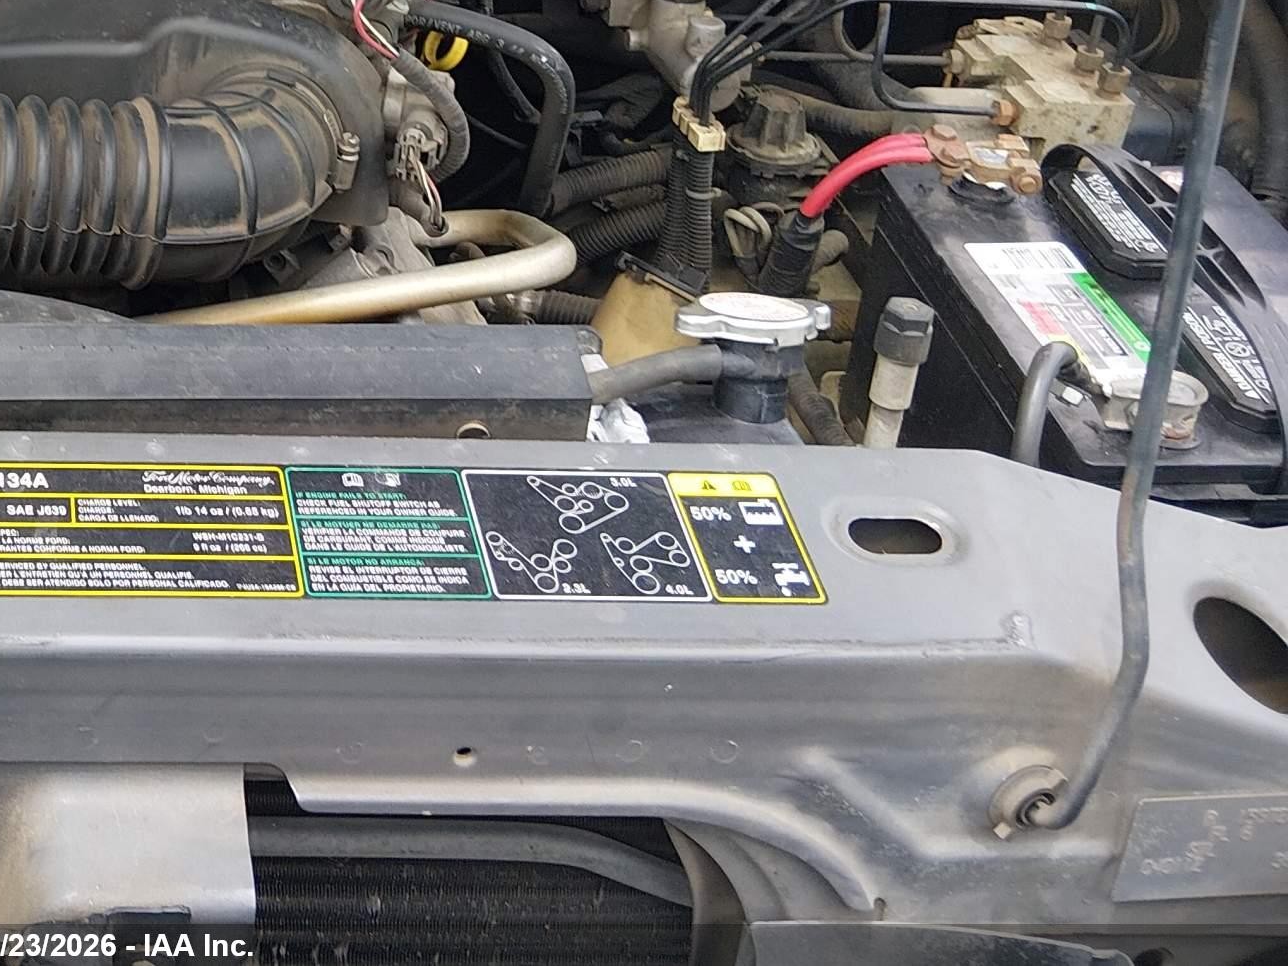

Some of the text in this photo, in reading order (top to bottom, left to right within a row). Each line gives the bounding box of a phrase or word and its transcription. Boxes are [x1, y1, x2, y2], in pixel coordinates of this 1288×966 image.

[143, 484, 248, 496] Dearborn, Michigan
[6, 504, 34, 515] SAE
[194, 506, 208, 516] 14
[689, 505, 732, 522] 50%
[714, 569, 759, 586] 50%
[665, 583, 695, 595] 4.0L
